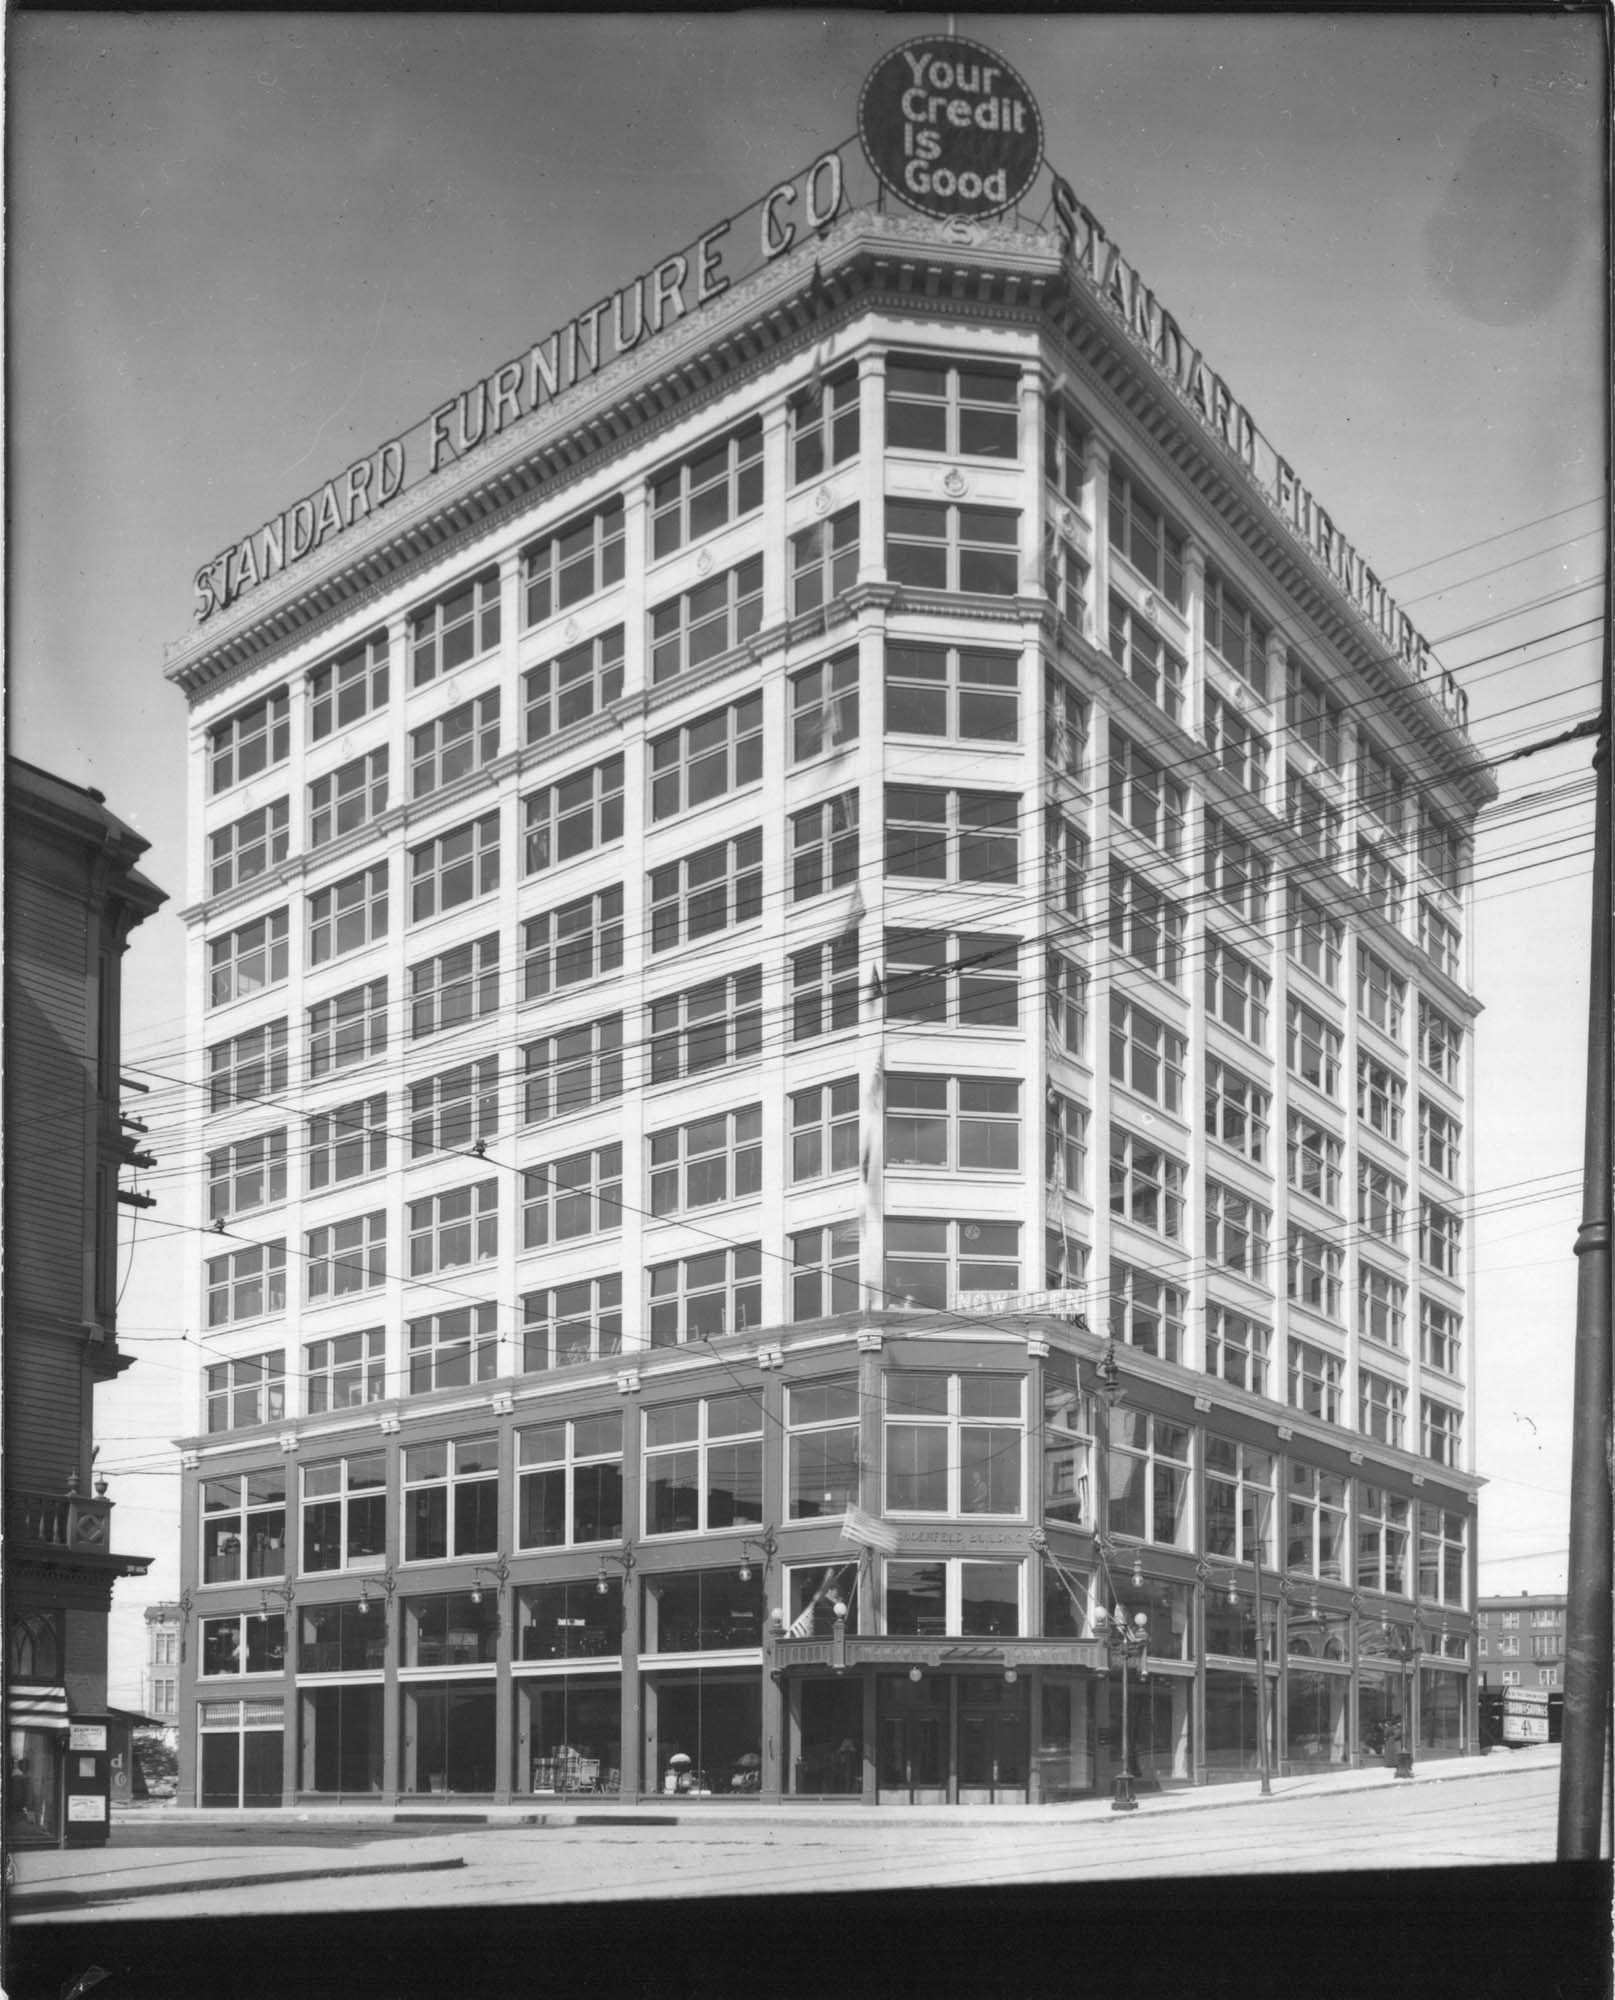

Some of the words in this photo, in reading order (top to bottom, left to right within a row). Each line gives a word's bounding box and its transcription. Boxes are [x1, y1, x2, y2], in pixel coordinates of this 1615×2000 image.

[903, 50, 1001, 94] Your
[901, 87, 1027, 134] Credit
[904, 122, 942, 160] Is
[904, 158, 1007, 202] Good
[1051, 176, 1255, 474] STANDARD
[192, 438, 404, 622] STANDARD
[429, 219, 731, 474] FURNITURE
[760, 152, 842, 260] CO
[1016, 1290, 1085, 1313] OPEN
